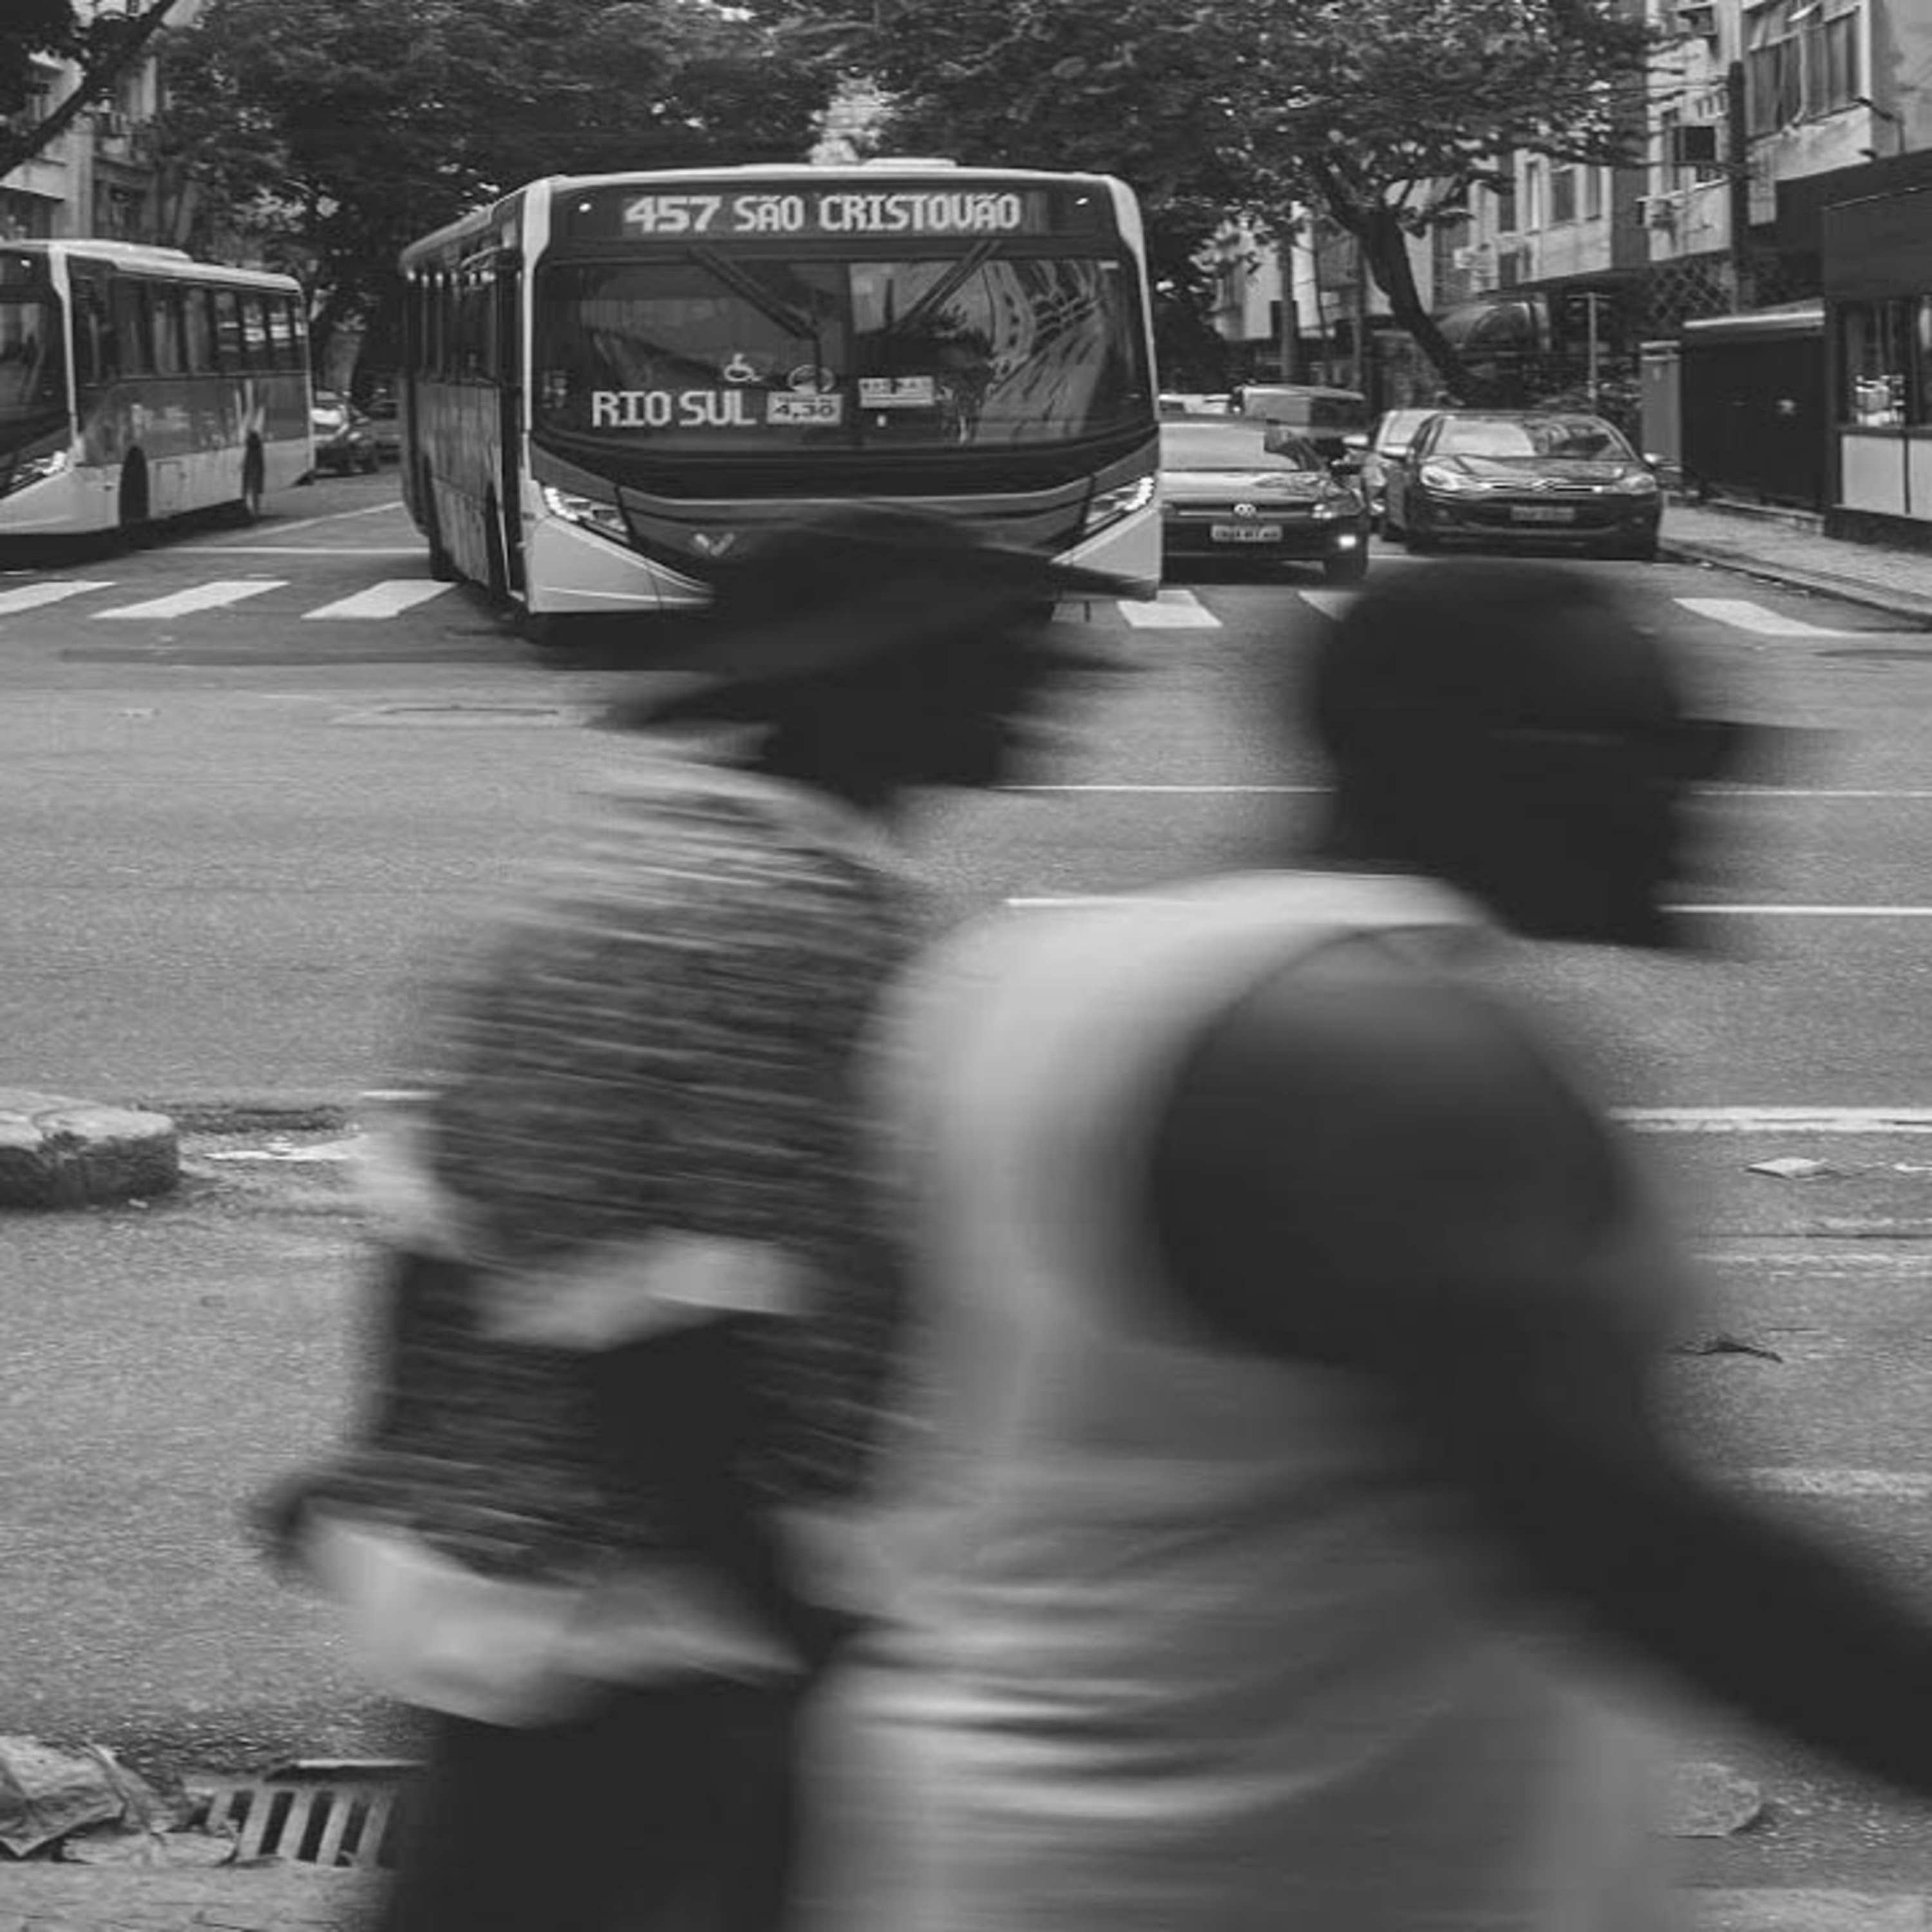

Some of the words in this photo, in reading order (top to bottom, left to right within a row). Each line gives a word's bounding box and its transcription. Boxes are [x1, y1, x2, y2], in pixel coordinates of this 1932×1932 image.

[624, 195, 721, 232] 457
[733, 194, 804, 231] SÃO
[819, 194, 1021, 231] CRISTOVÃO
[591, 390, 672, 427] RIO
[678, 390, 757, 426] SUL
